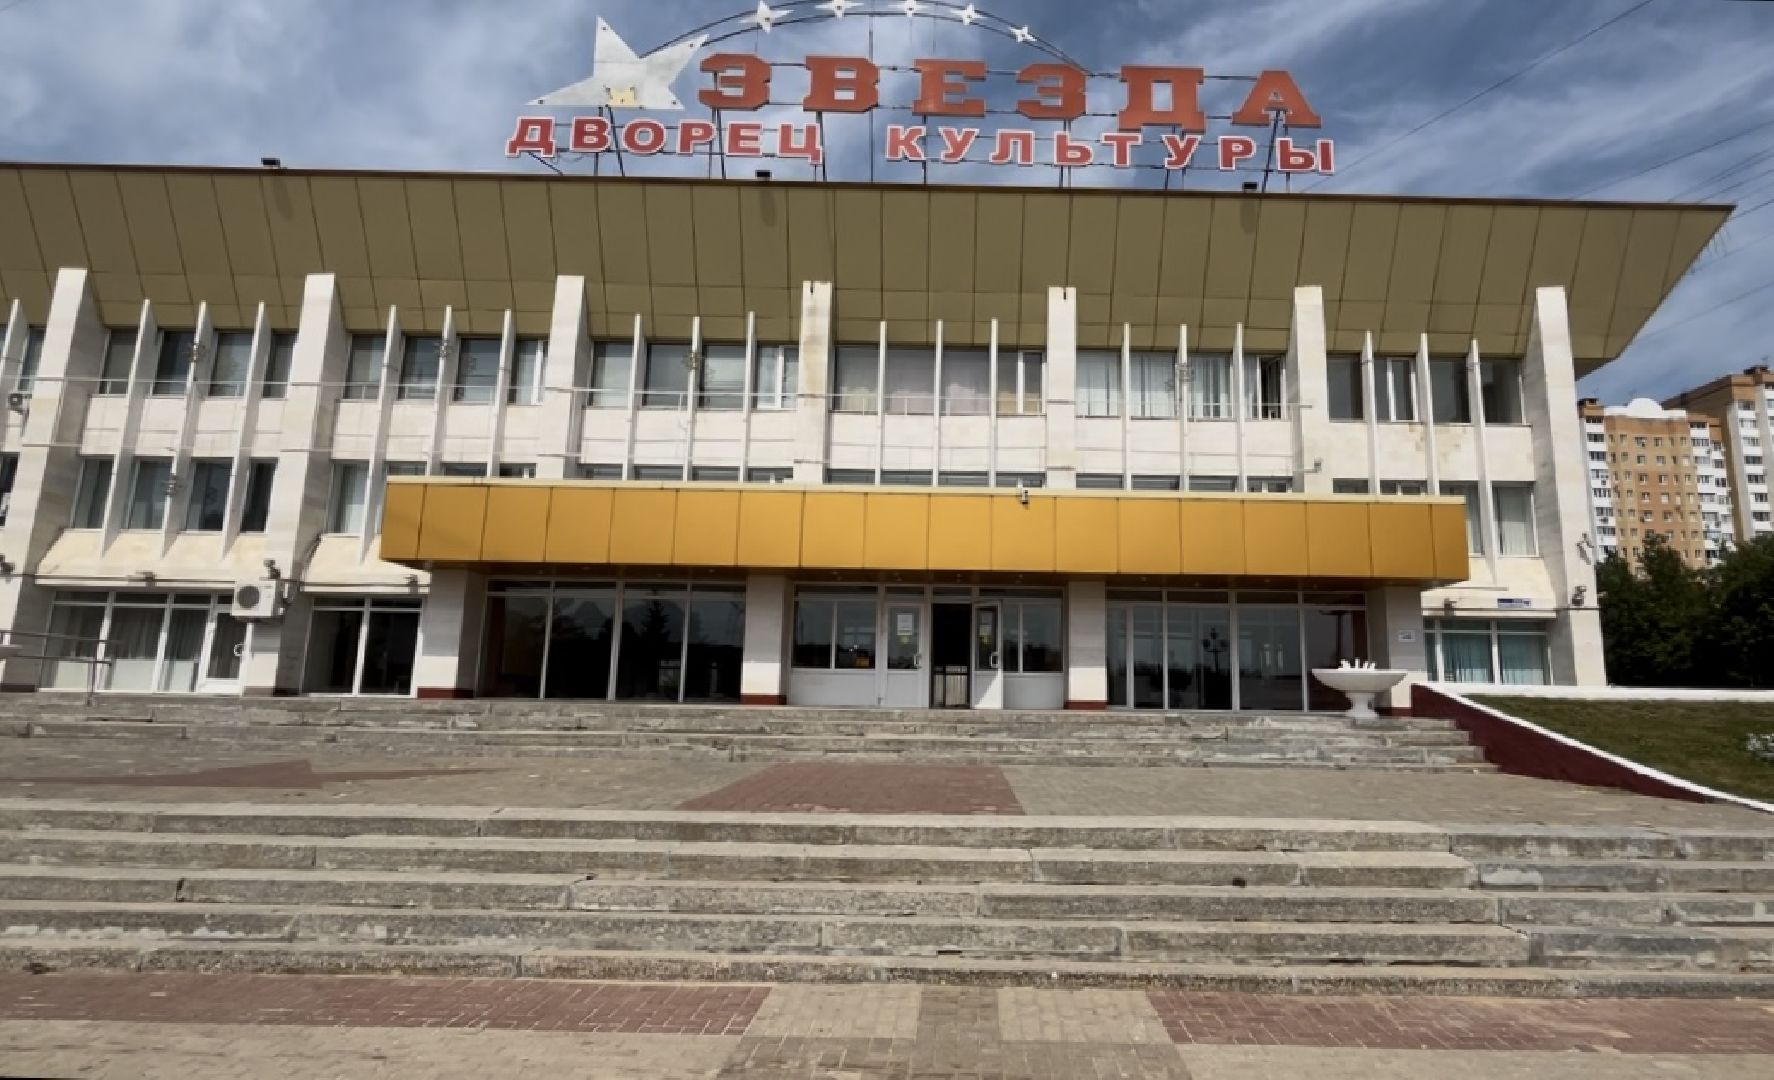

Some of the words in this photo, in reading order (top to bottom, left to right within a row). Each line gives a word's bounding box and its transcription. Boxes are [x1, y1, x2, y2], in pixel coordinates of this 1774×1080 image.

[697, 53, 1322, 132] ЗВЕЗДА
[505, 116, 823, 165] ДВОРЕЦ
[885, 125, 1335, 175] КУЛЬТУРЫ
